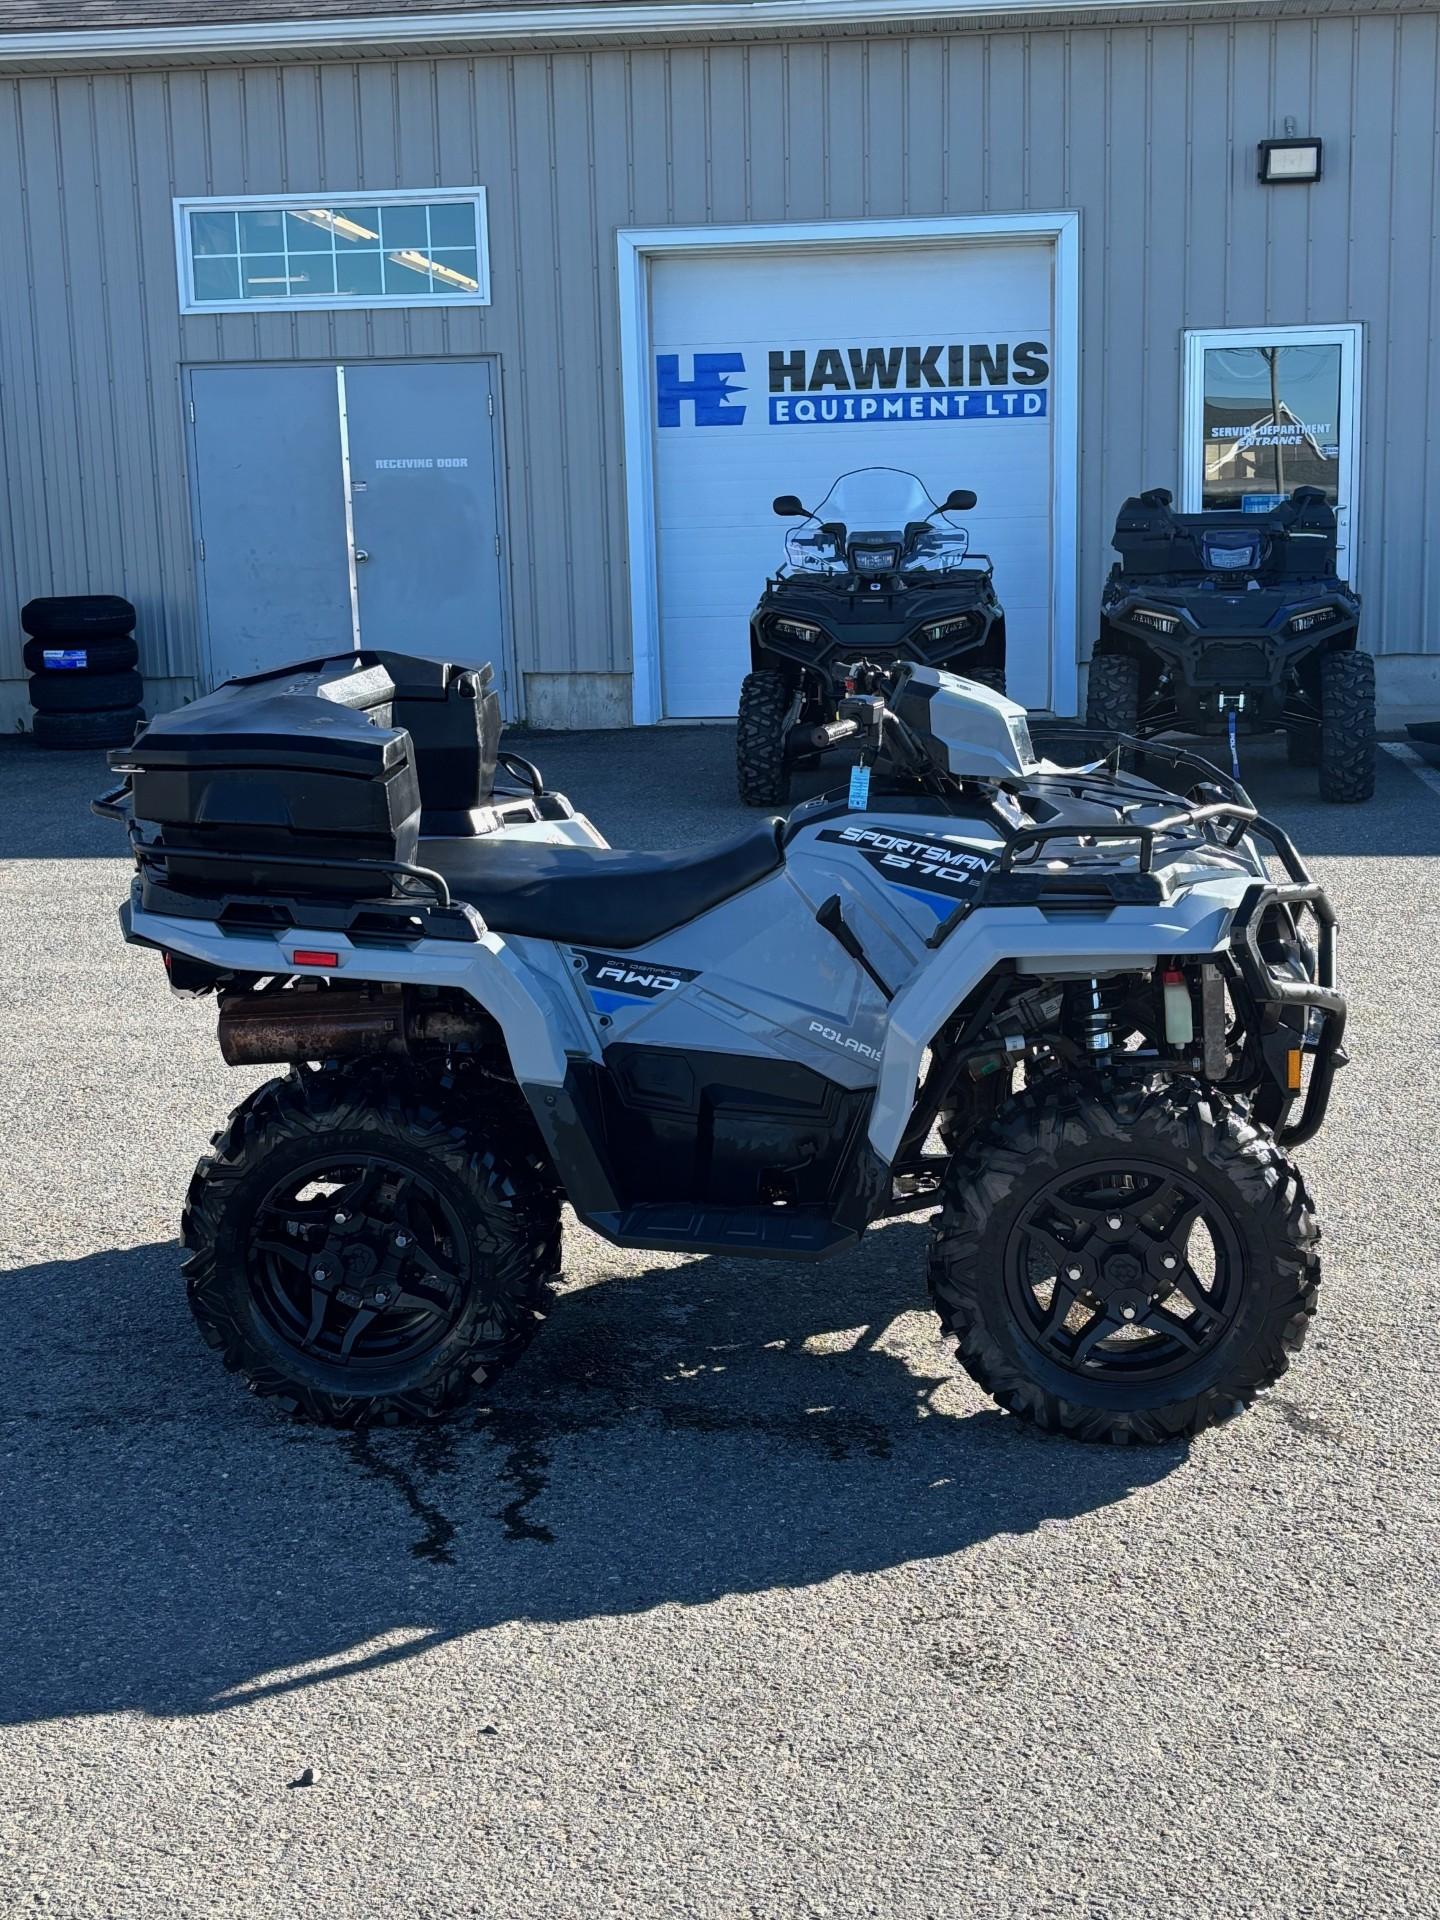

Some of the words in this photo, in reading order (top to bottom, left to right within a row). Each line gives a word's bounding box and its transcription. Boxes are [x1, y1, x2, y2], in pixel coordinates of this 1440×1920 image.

[768, 341, 1050, 393] HAWKINS
[776, 394, 970, 422] EQUIPMENT
[986, 393, 1042, 415] LTD
[1211, 426, 1257, 438] SERVICE
[1259, 423, 1332, 436] DEPARTMENT
[1239, 435, 1304, 447] ENTRANCE
[375, 459, 433, 469] RECEIVING
[437, 458, 468, 468] DOOR
[838, 826, 996, 873] SPORTSMAN
[879, 852, 970, 883] 570
[596, 966, 681, 991] AWD
[808, 1020, 883, 1062] POLARIS
